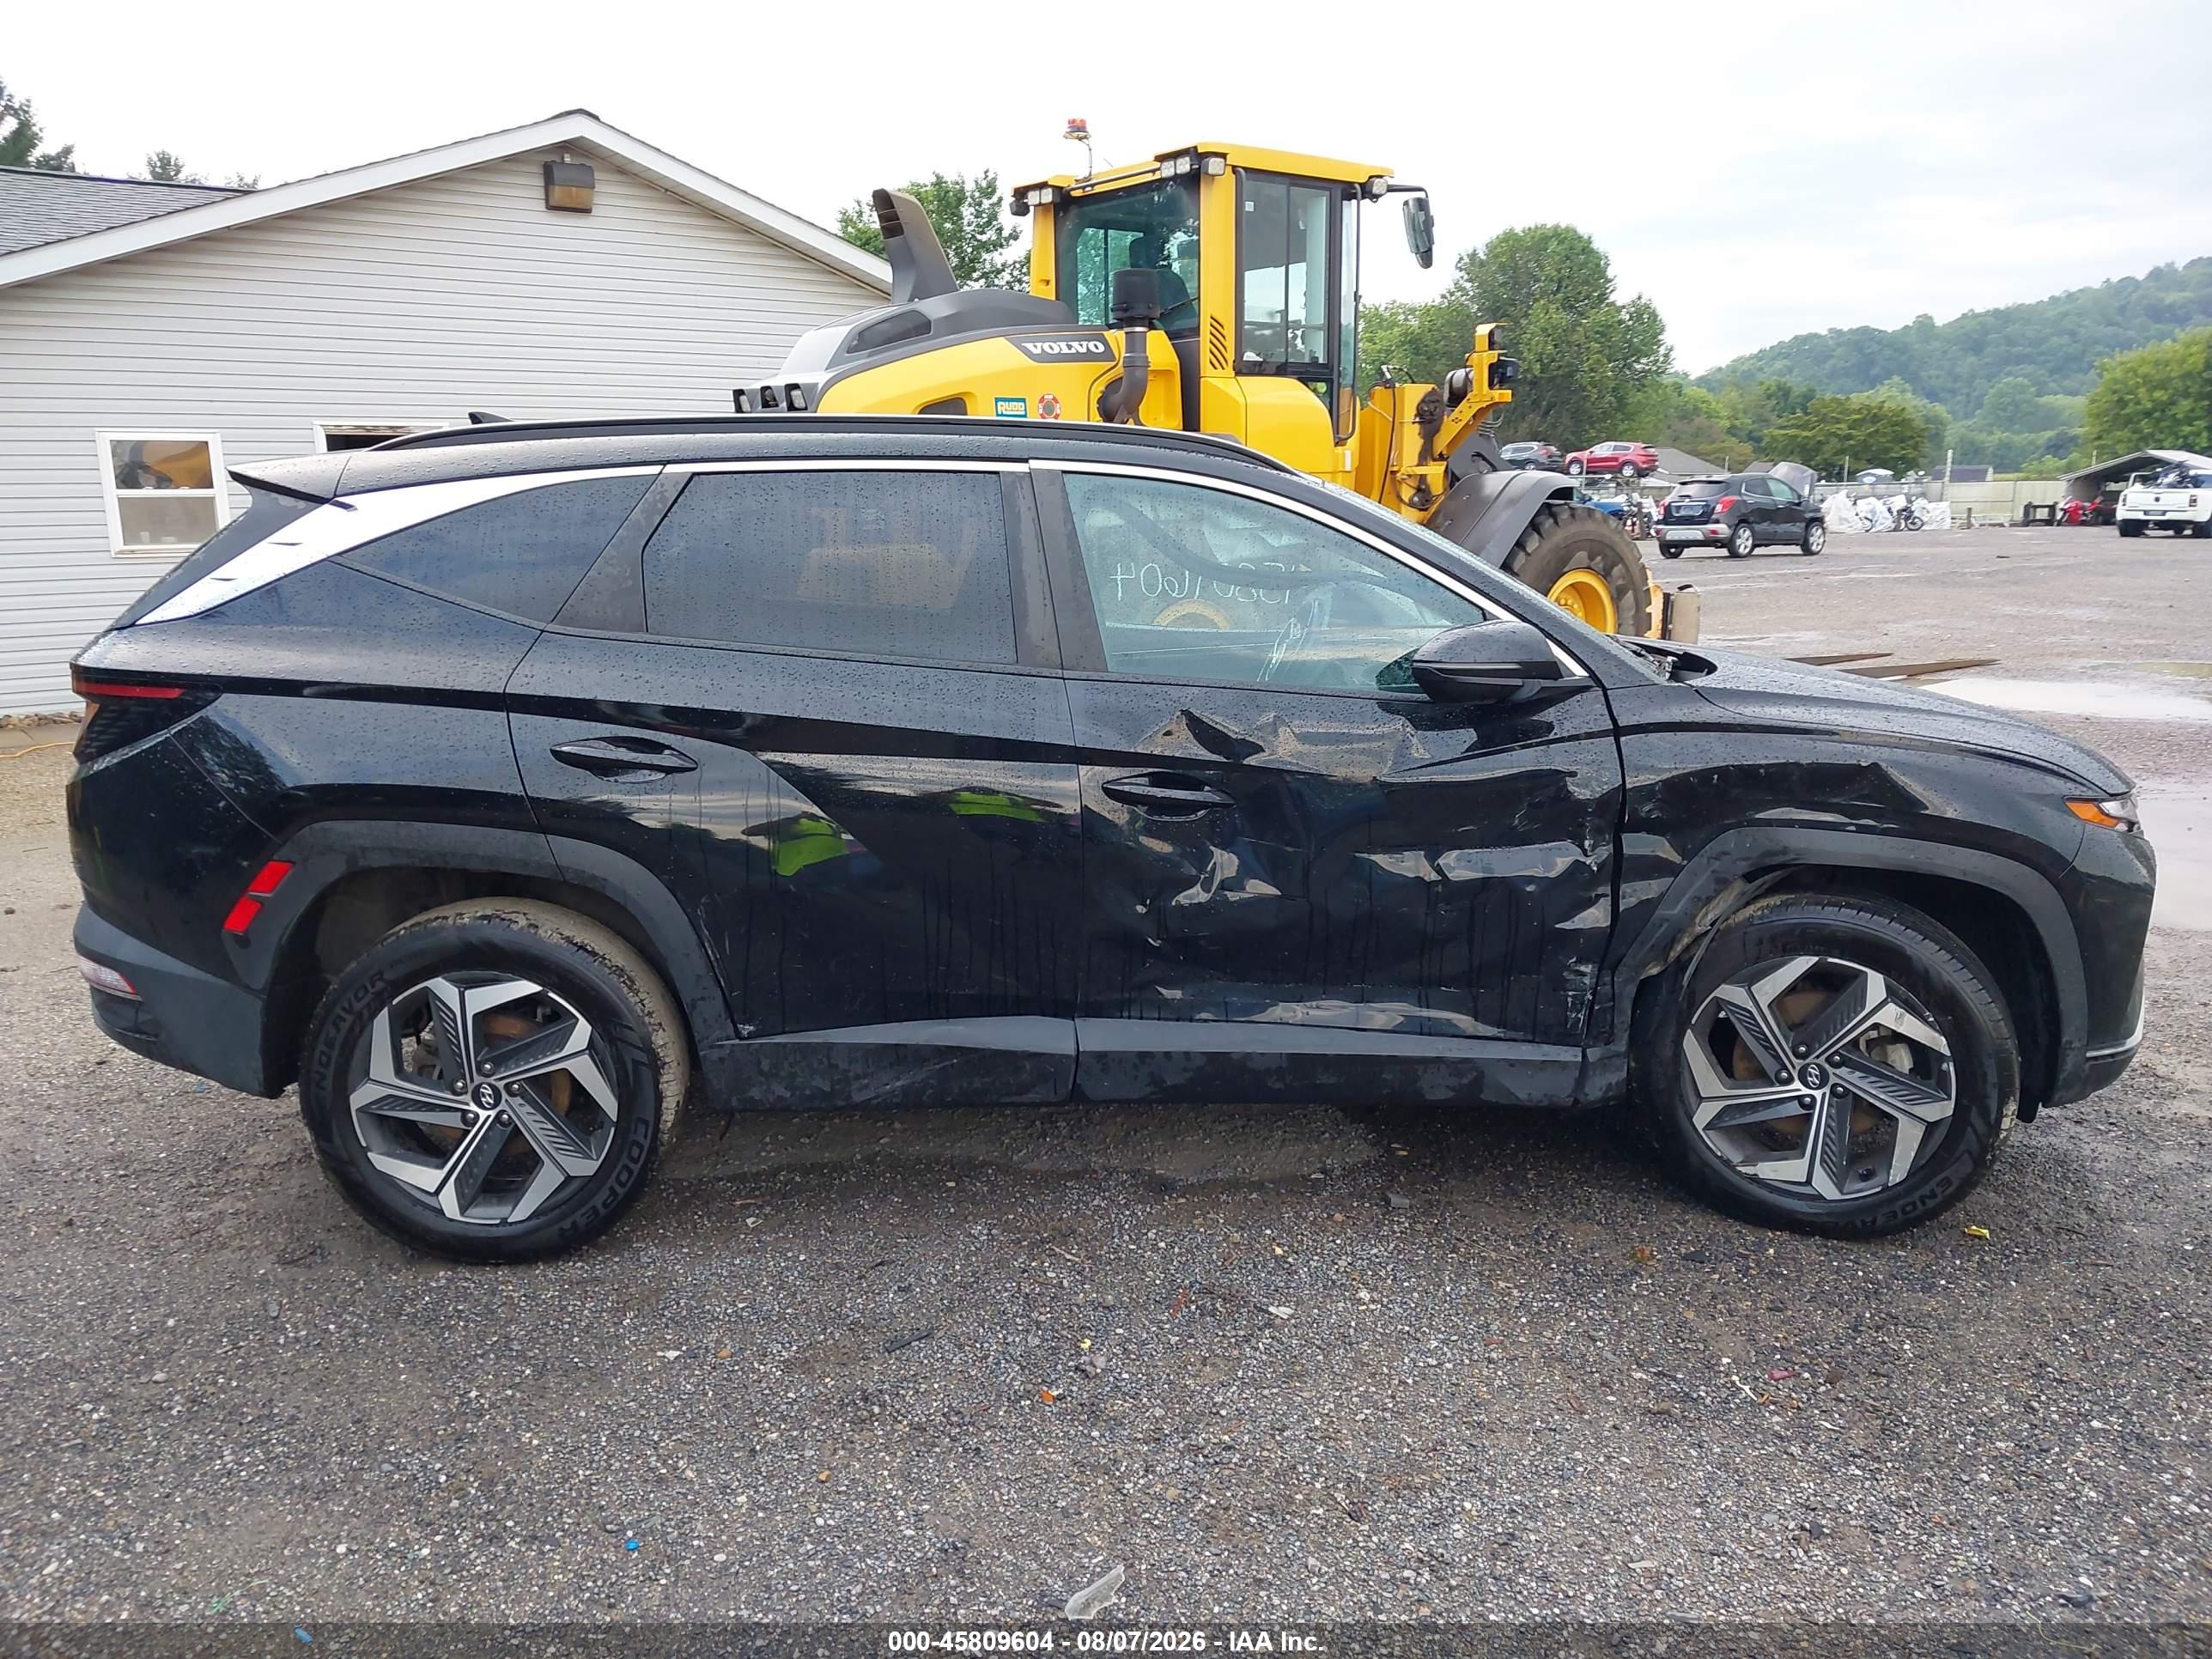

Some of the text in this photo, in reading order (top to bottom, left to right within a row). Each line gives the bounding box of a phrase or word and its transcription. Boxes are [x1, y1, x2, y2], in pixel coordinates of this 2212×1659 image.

[1021, 341, 1105, 355] VOLVO
[314, 969, 384, 1102] NDEAVOR
[558, 1115, 650, 1237] COOPER
